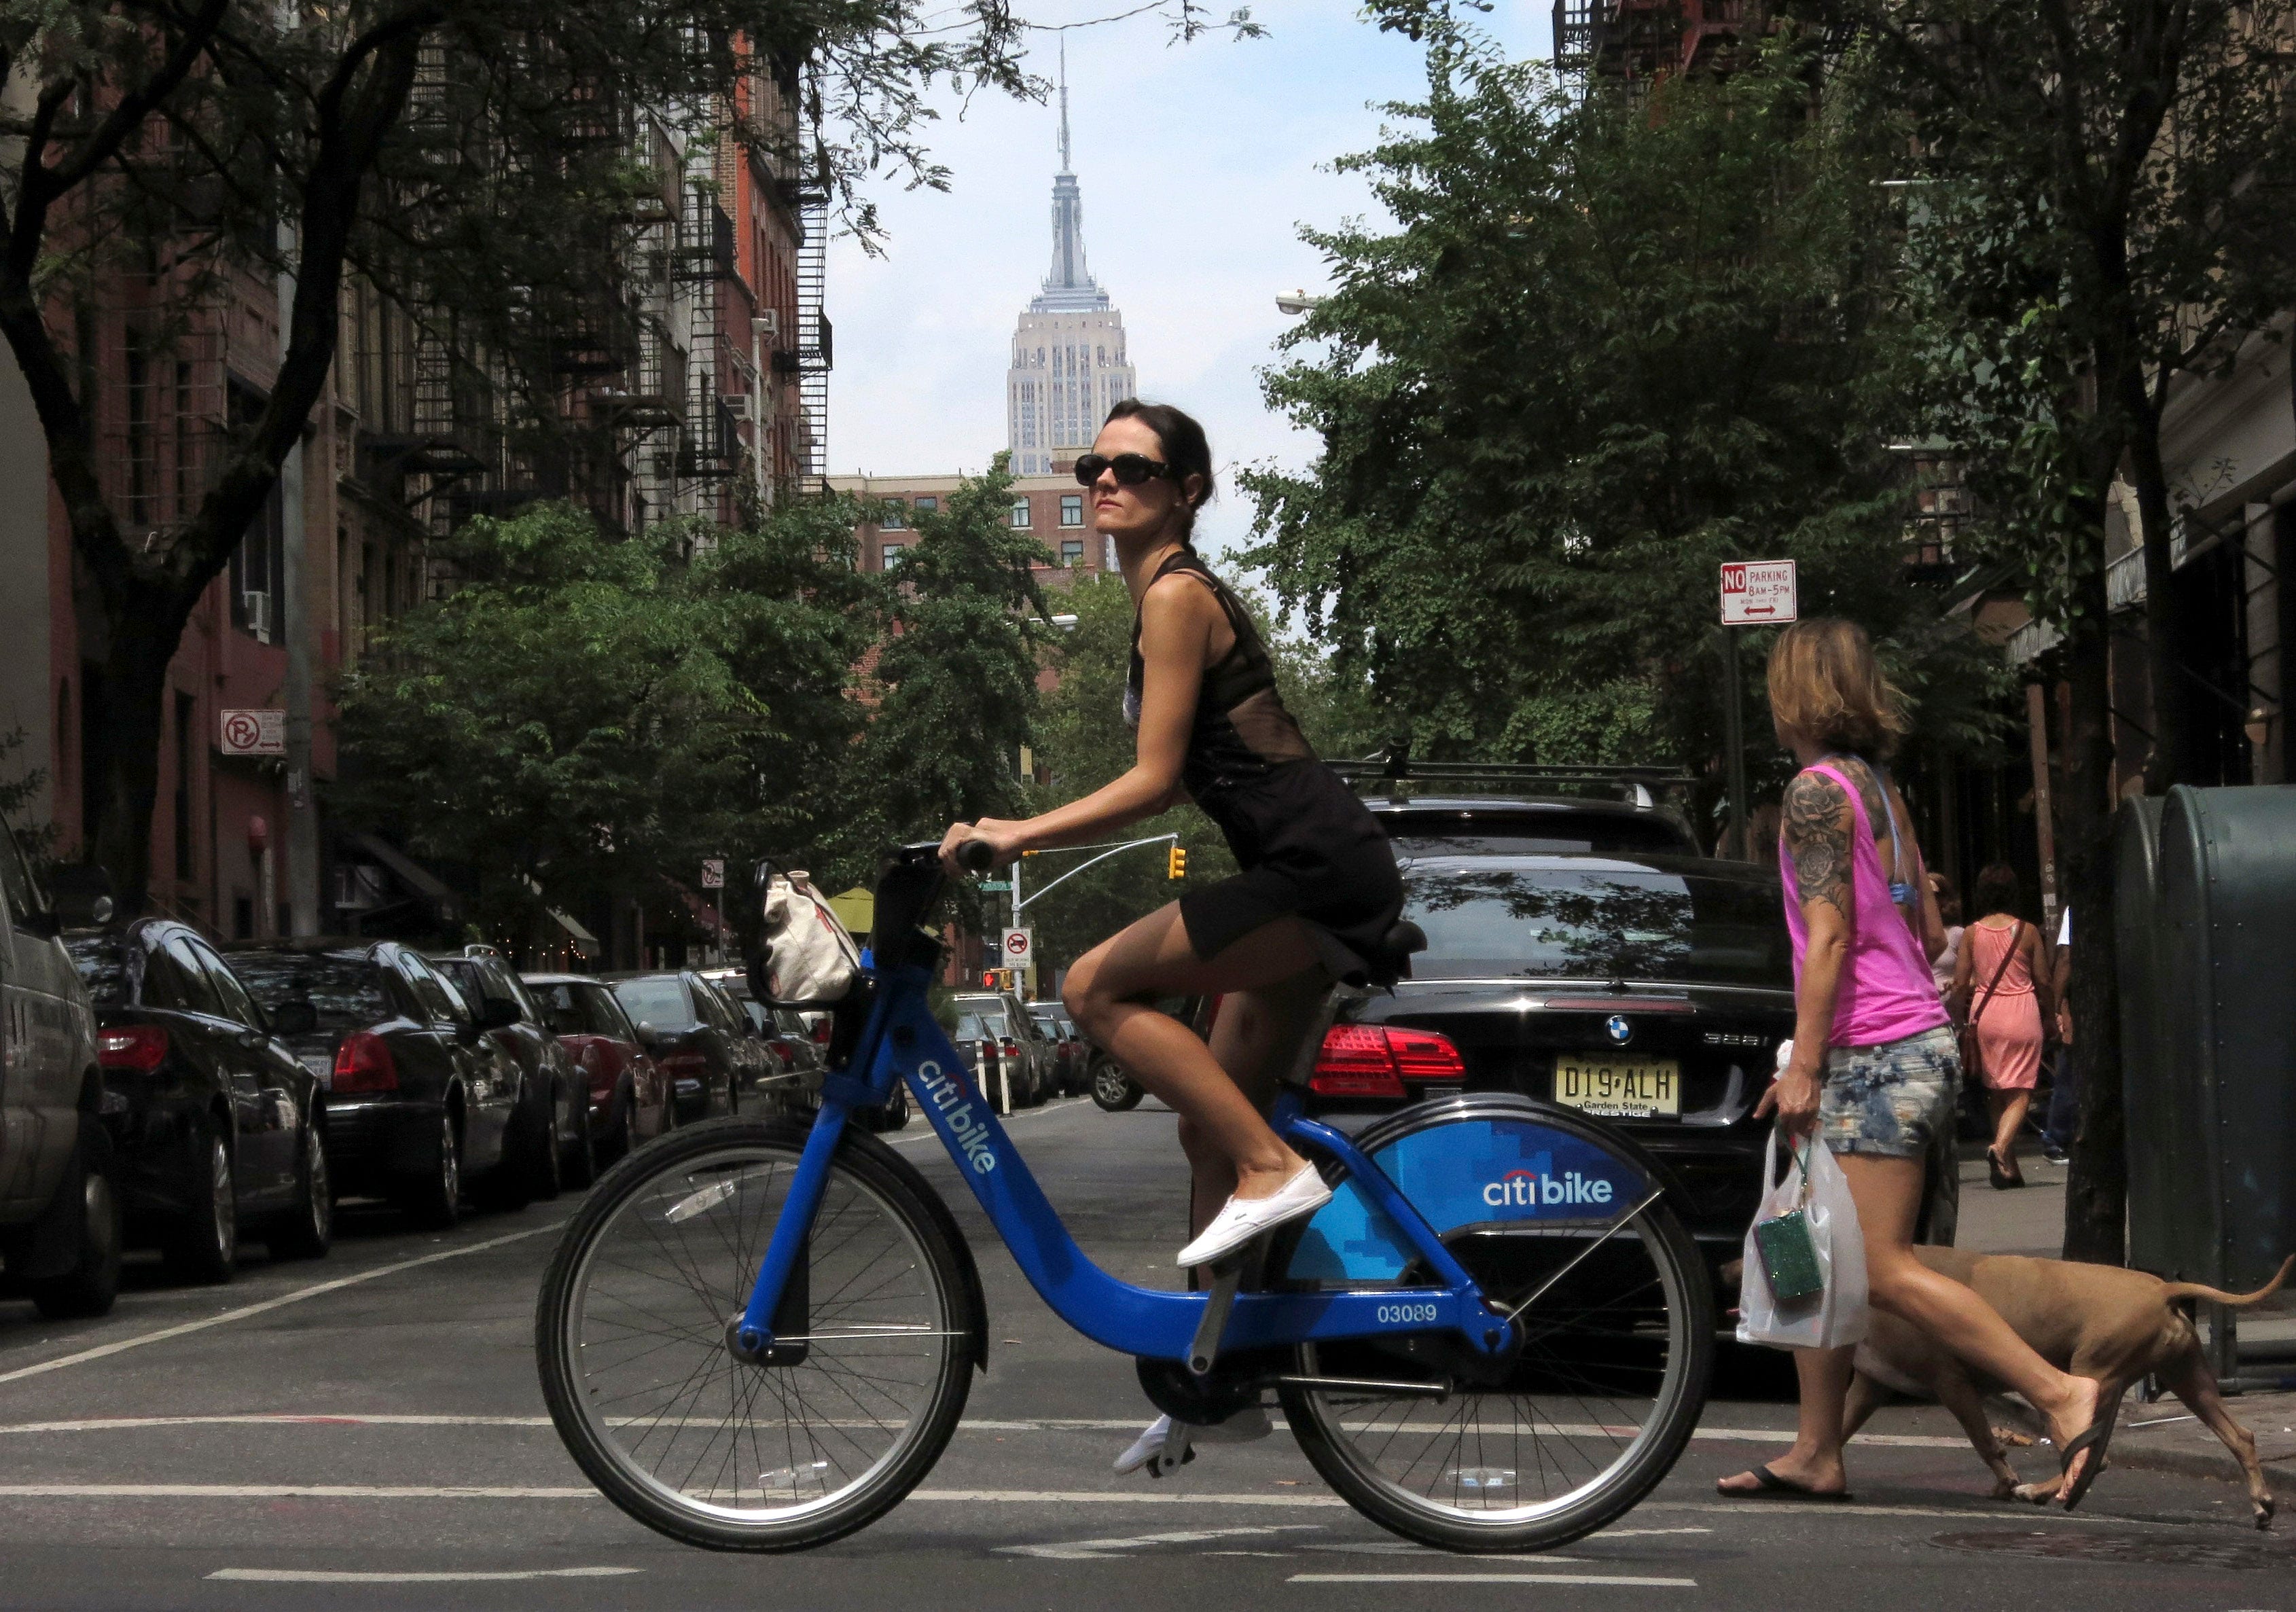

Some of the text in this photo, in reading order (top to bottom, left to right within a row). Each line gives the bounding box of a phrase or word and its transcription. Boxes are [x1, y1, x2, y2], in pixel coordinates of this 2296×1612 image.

[1724, 569, 1746, 590] NO
[1750, 570, 1788, 583] PARKING
[1748, 584, 1789, 596] 8AM-5PM
[1583, 1100, 1648, 1111] Garden State
[946, 1103, 996, 1175] bike
[1483, 1171, 1613, 1206] citi bike
[1377, 1304, 1437, 1323] 03089
